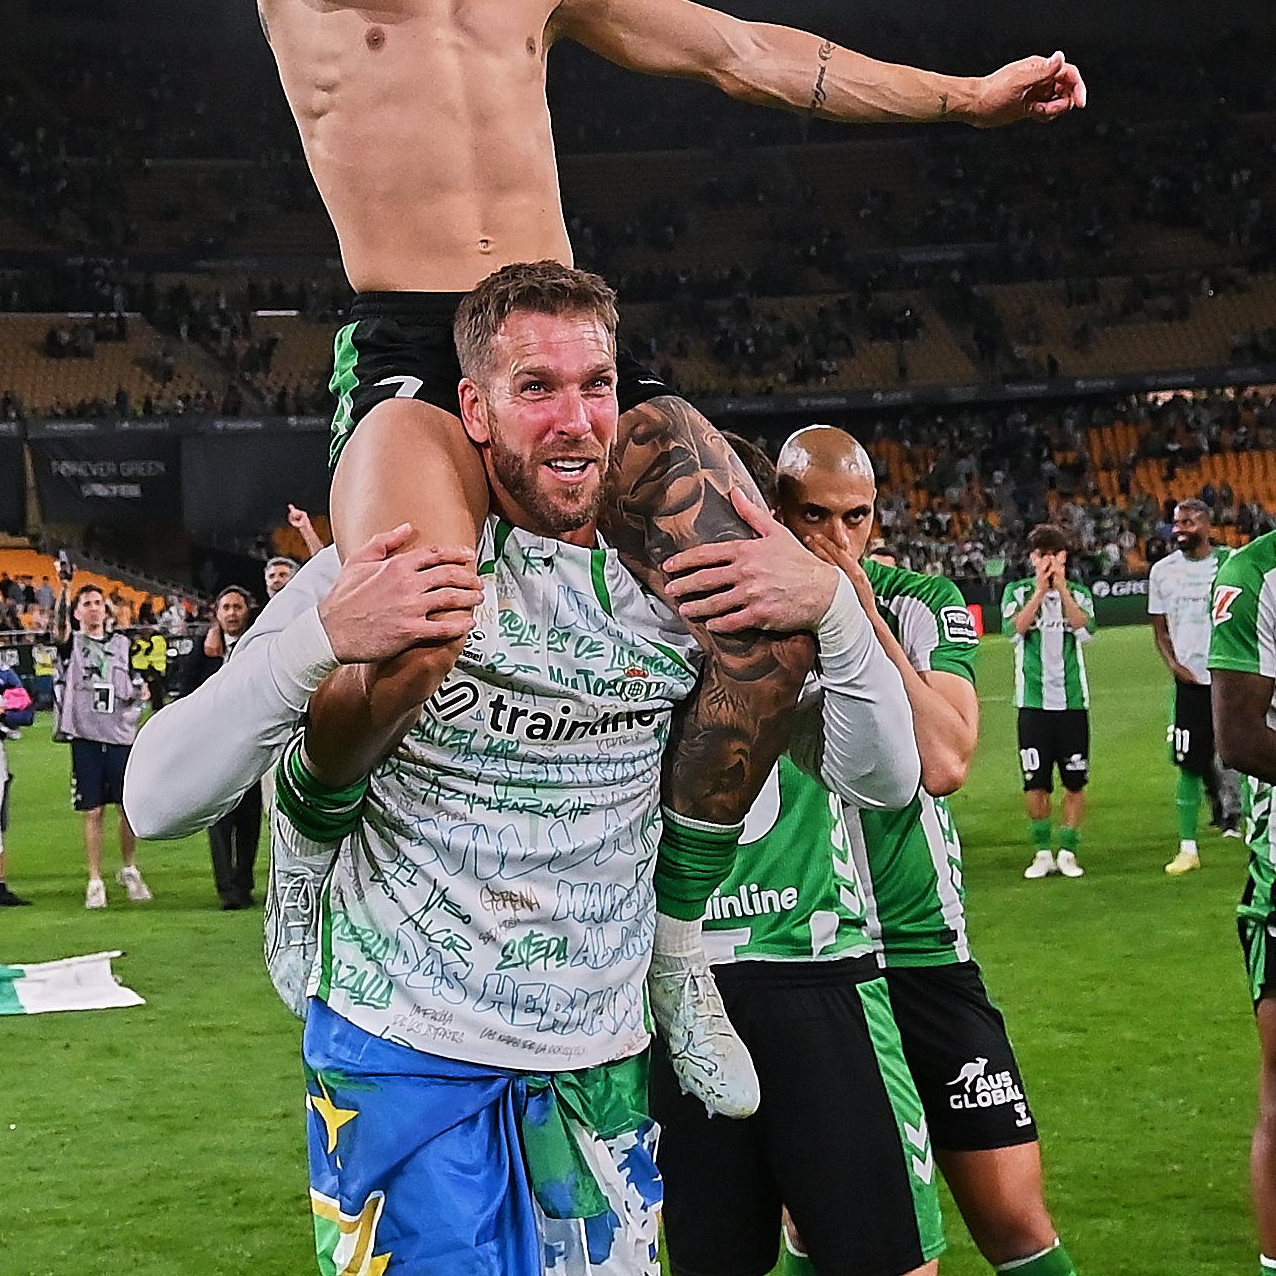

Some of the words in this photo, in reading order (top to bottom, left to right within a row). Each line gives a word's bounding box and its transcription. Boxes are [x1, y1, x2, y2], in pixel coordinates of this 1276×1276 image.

[1175, 727, 1190, 754] 11
[1020, 747, 1040, 771] 10
[975, 1070, 1013, 1093] AUS
[949, 1084, 1024, 1110] GLOBAL
